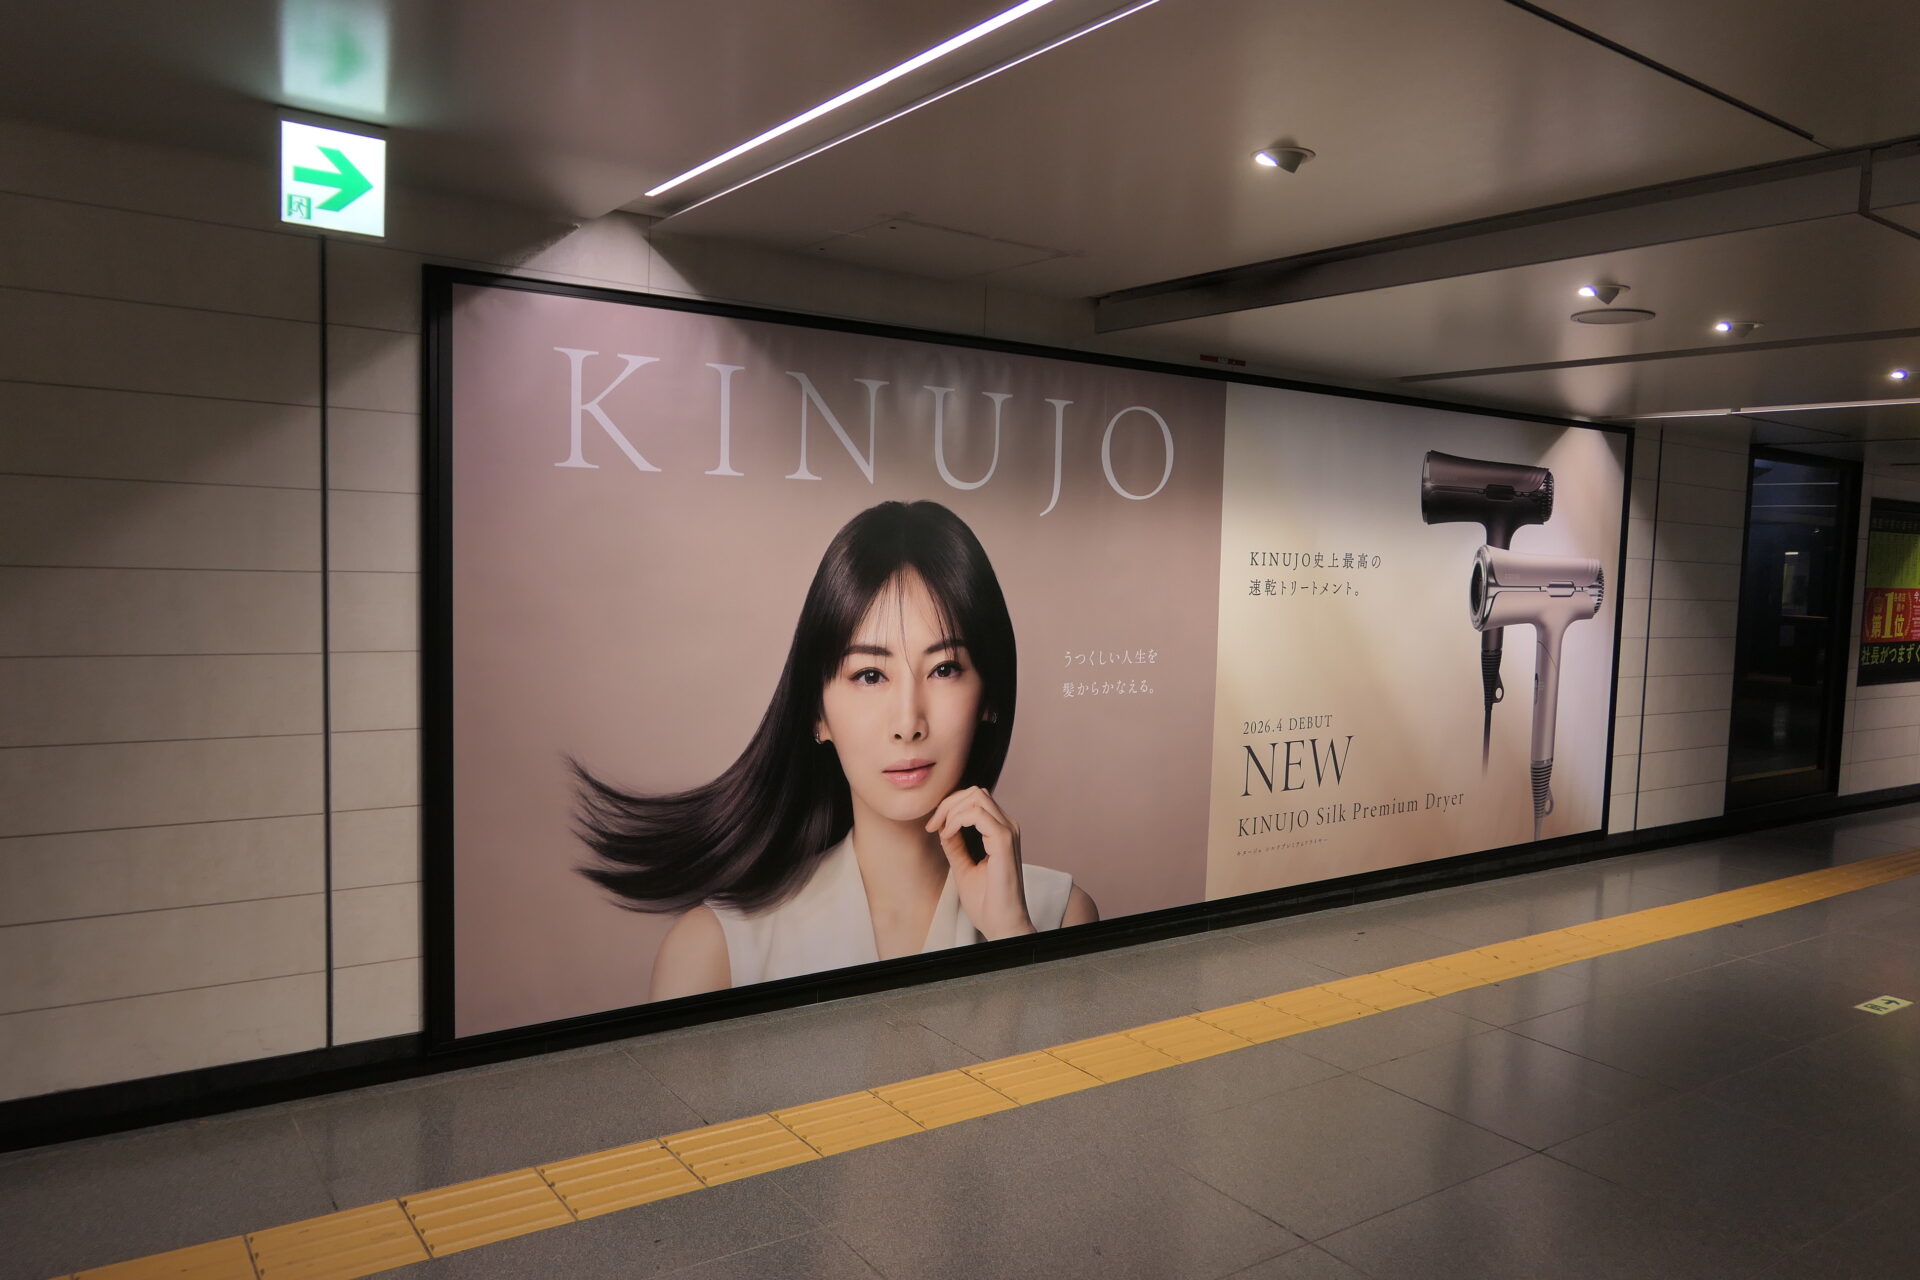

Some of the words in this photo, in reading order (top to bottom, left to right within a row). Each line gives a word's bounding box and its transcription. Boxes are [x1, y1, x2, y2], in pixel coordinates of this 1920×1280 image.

[554, 347, 1175, 516] KINUJO
[1250, 551, 1382, 570] KINUJO史上最高の
[1249, 578, 1360, 597] 速乾トリートメント。
[1064, 648, 1158, 668] うつくしい人生を
[1062, 679, 1154, 698] 髪からかなえる。
[1243, 718, 1283, 735] 2026.4
[1289, 714, 1333, 731] DEBUT
[1240, 735, 1354, 797] NEW
[1237, 809, 1309, 837] KINUJO
[1316, 803, 1347, 826] Silk
[1353, 797, 1419, 821] Premium
[1425, 791, 1465, 813] Dryer
